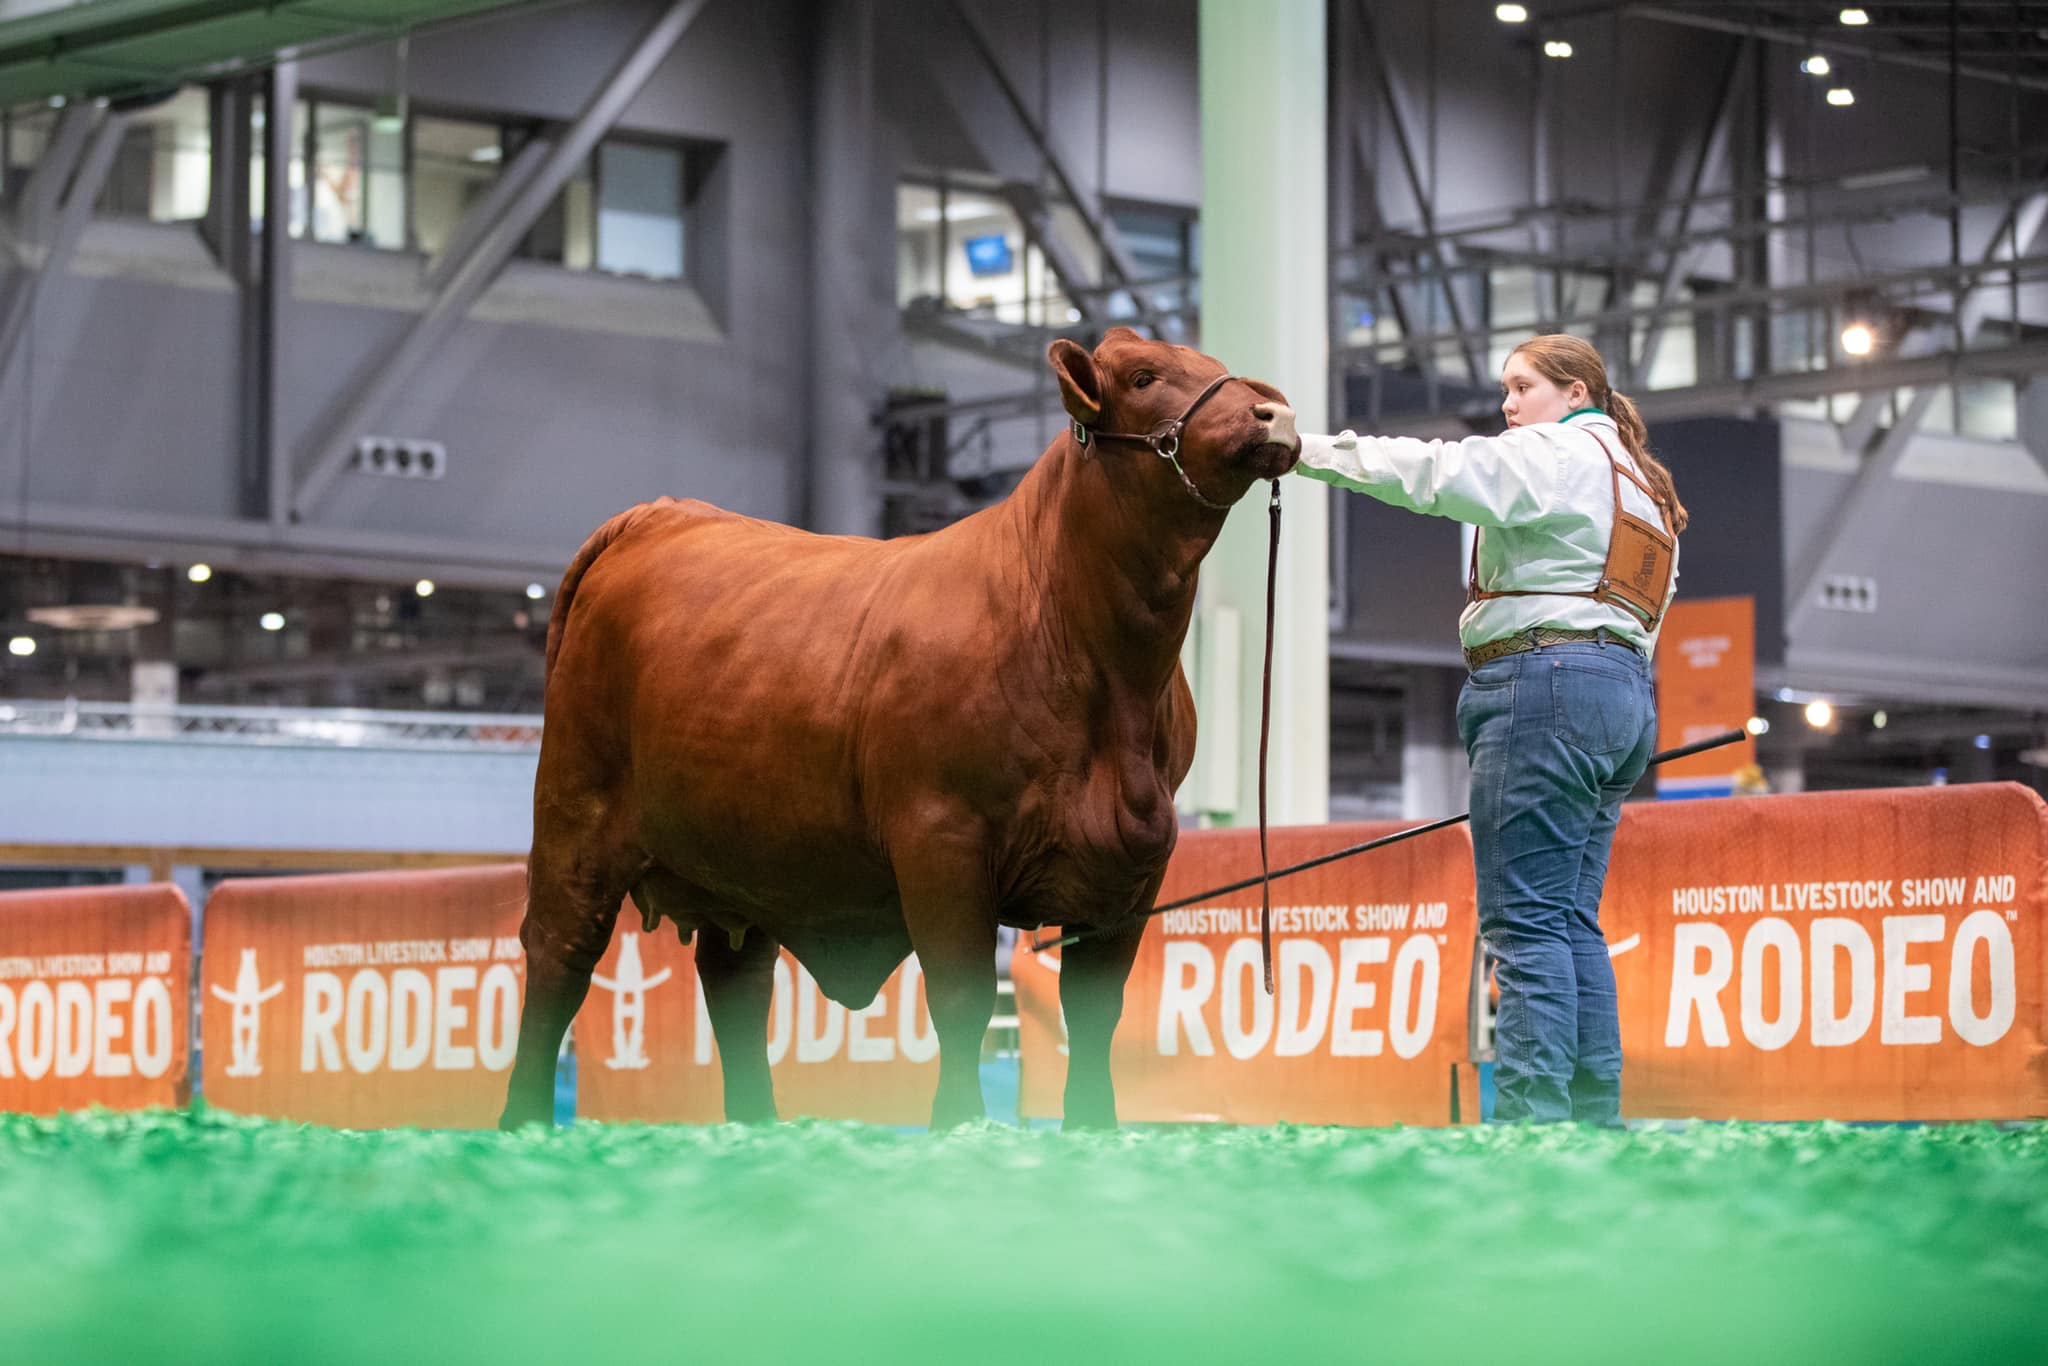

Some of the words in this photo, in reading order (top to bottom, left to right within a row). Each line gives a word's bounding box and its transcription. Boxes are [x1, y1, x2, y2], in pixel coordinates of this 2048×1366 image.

[1673, 885, 1764, 916] HOUSTON
[1771, 880, 1894, 912] LIVESTOCK
[1902, 877, 1967, 908] SHOW
[1973, 874, 2016, 904] AND
[1162, 907, 1242, 934] HOUSTON
[1355, 903, 1409, 931] SHOW
[1413, 902, 1448, 929] AND
[37, 953, 105, 978] LIVESTOCK
[108, 952, 144, 976] SHOW
[146, 950, 171, 973] AND
[304, 942, 364, 967] HOUSTON
[367, 939, 448, 965] LIVESTOCK
[450, 936, 491, 961] SHOW
[494, 935, 524, 960] AND
[1157, 933, 1440, 1060] RODEO
[1664, 909, 2017, 1051] RODEO
[301, 963, 519, 1074] RODEO
